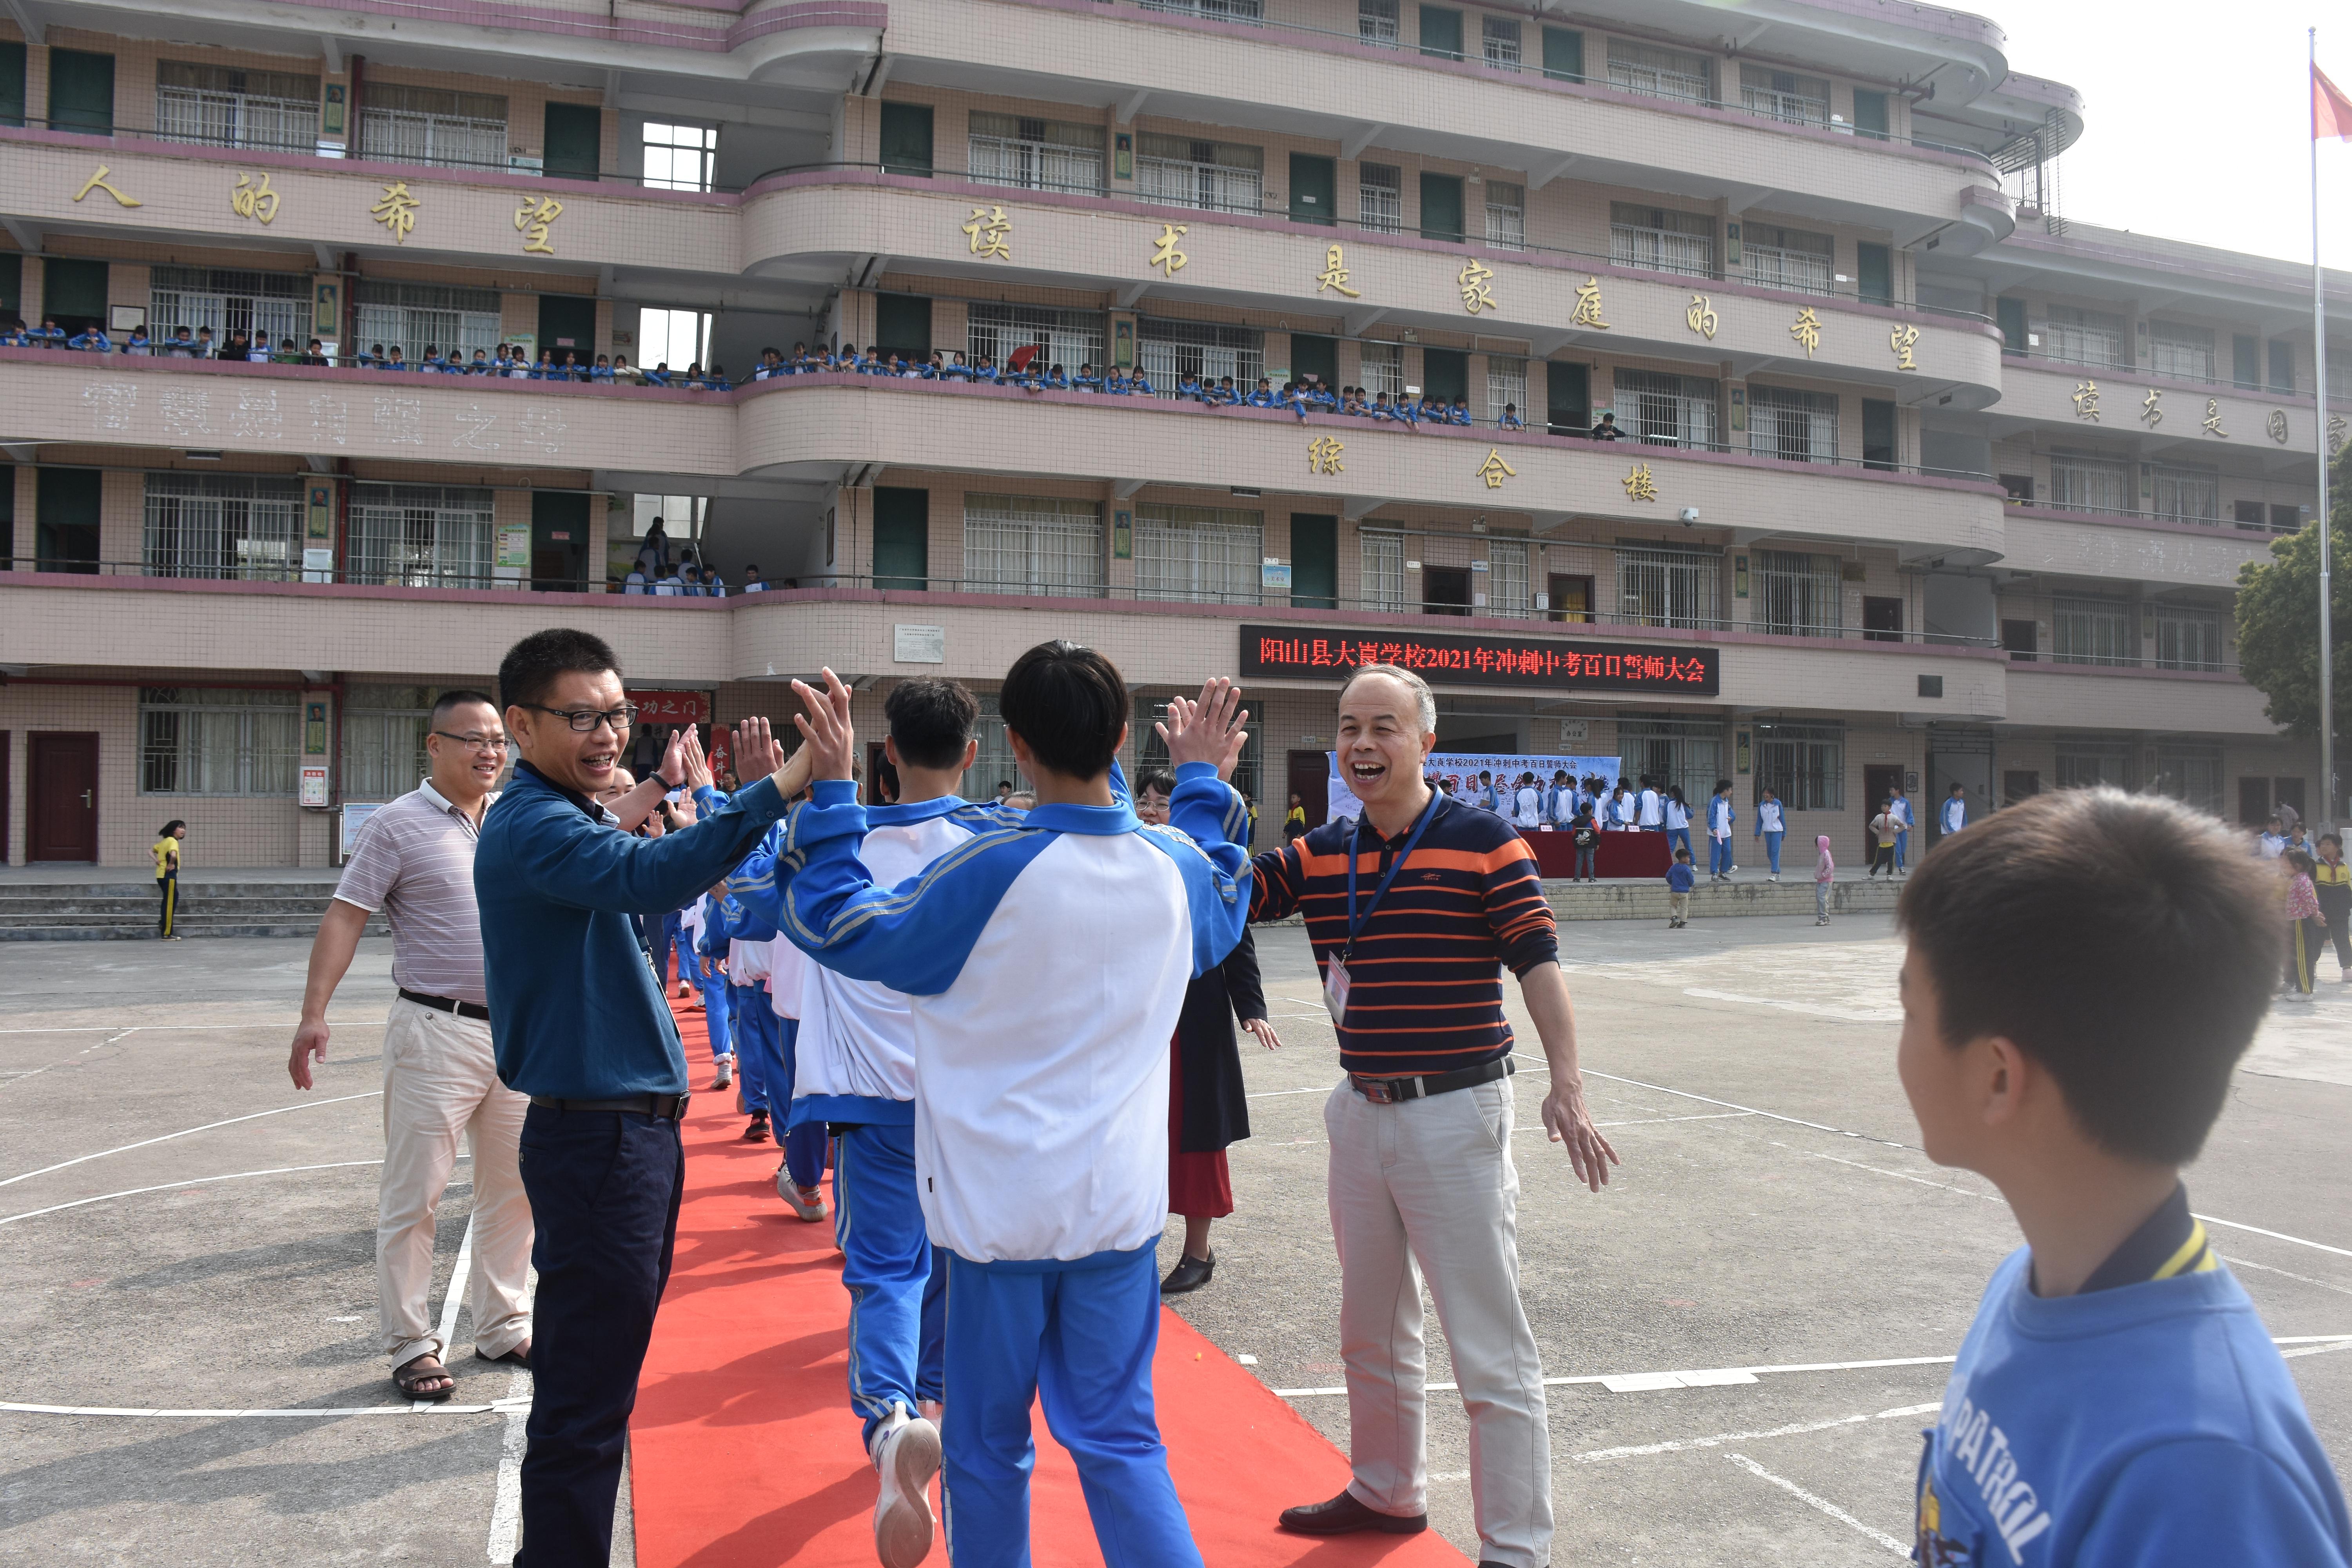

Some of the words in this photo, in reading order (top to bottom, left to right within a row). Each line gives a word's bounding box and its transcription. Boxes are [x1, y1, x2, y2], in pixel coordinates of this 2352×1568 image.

[73, 164, 563, 254] 人的希望
[962, 205, 1920, 370] 读书是家庭的希望
[1308, 436, 1659, 502] 综合楼
[1947, 1397, 2053, 1566] PATROL
